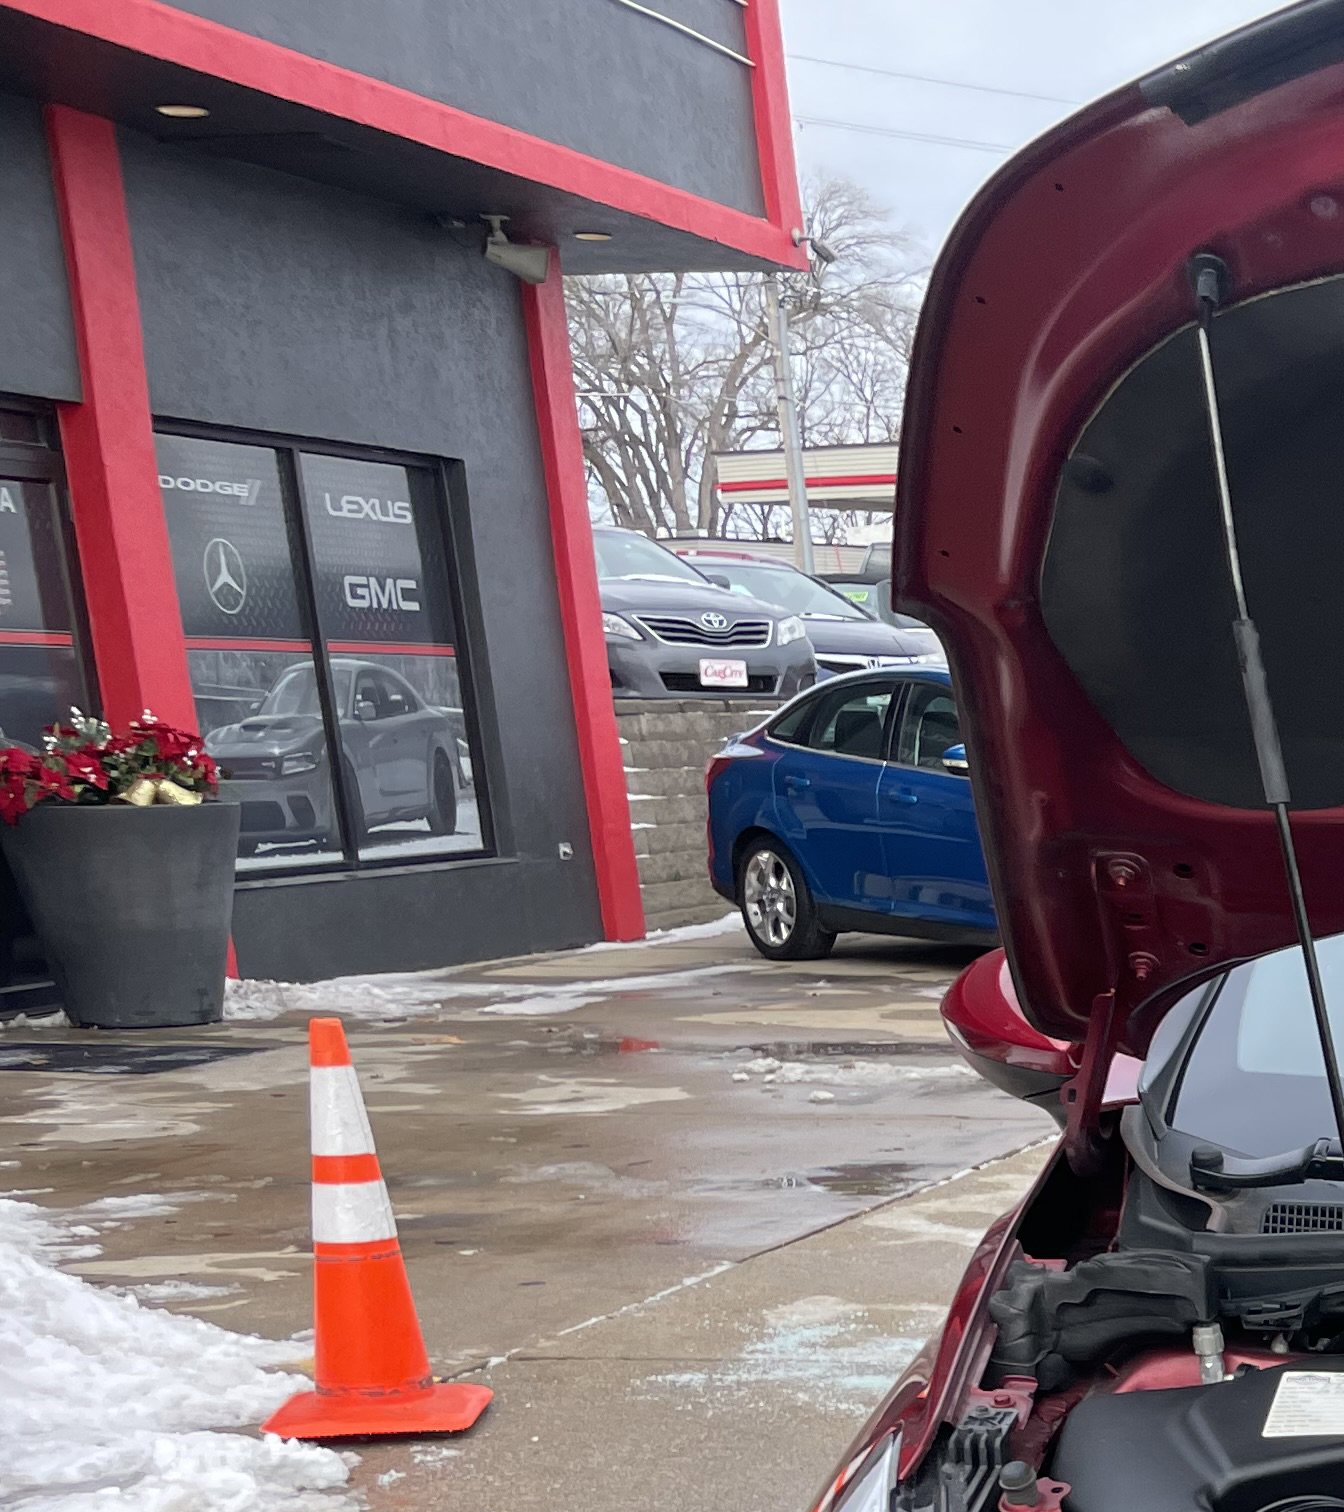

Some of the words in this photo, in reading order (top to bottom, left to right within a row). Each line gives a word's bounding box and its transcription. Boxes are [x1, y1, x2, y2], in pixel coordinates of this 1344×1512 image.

[158, 474, 249, 497] DODGE
[325, 492, 413, 524] LEXUS
[343, 575, 420, 612] GMC
